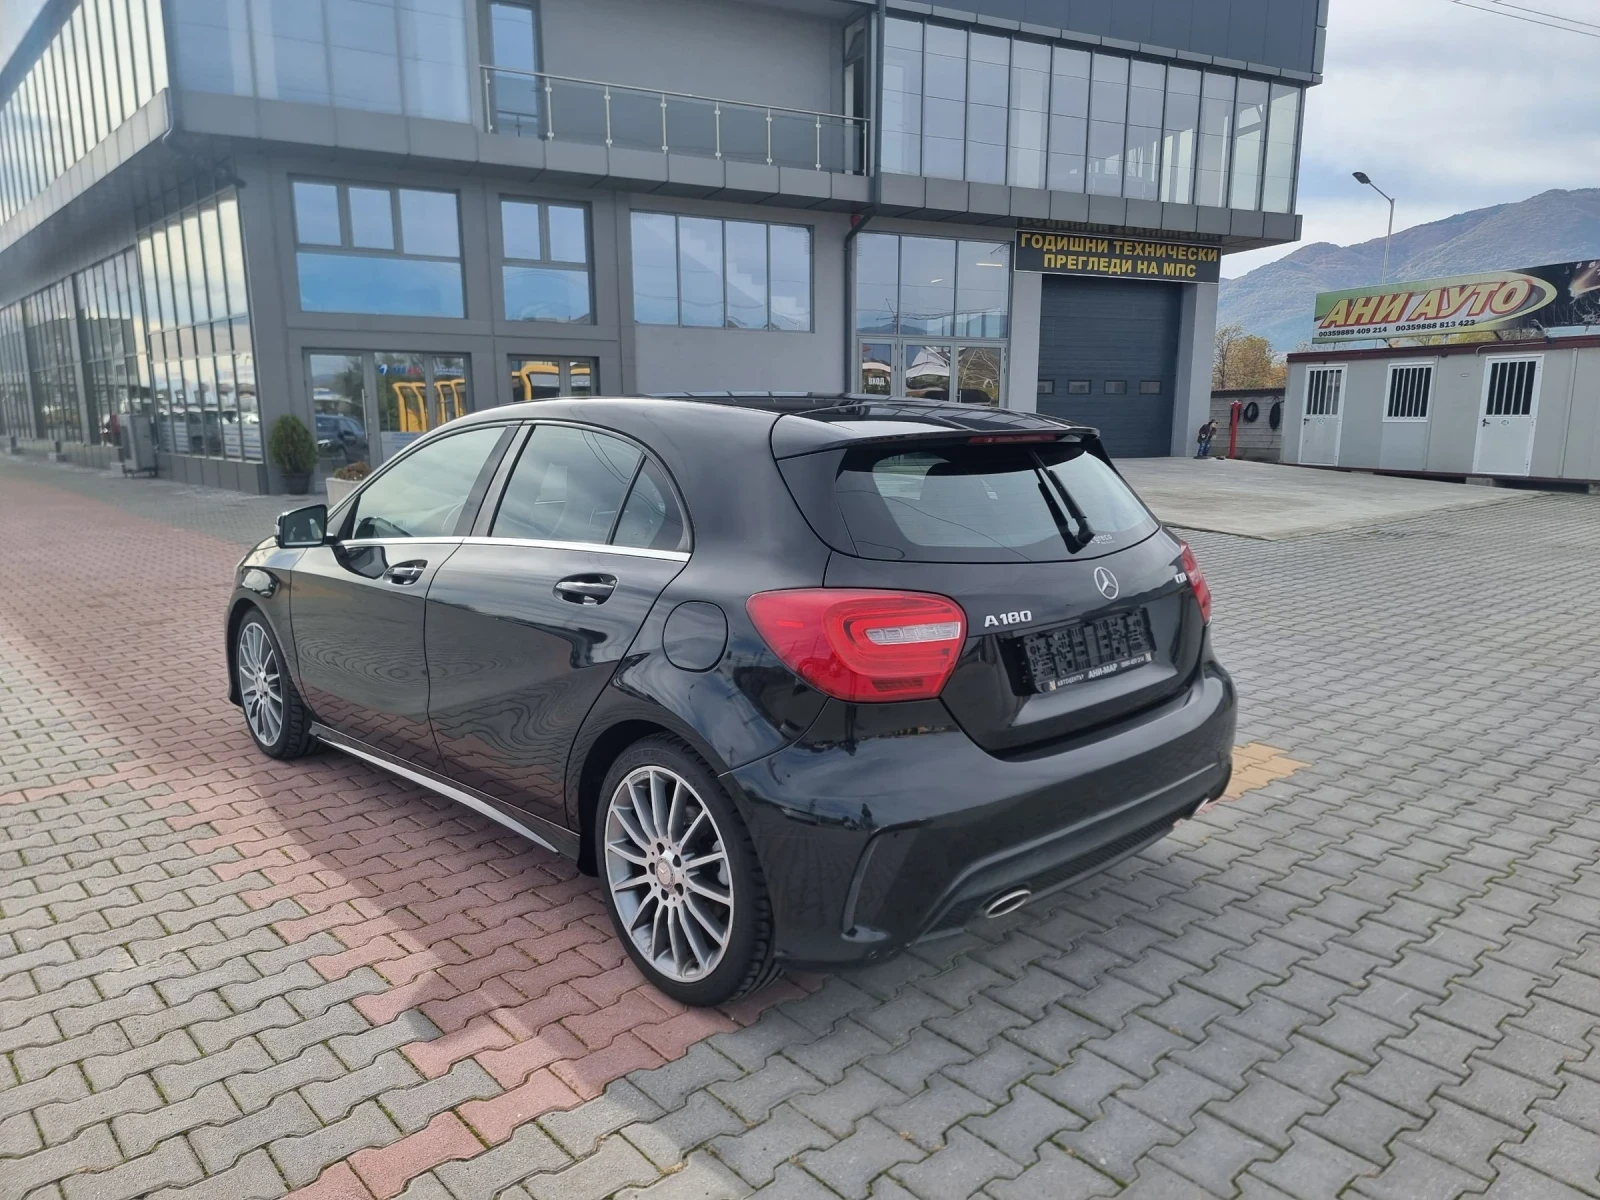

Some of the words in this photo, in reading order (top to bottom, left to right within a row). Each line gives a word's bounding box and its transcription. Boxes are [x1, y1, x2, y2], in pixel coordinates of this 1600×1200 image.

[1021, 233, 1108, 253] ГОДИШНИ
[1113, 240, 1218, 262] ТЕХНИЧЕСКИ
[1043, 253, 1133, 275] ПРЕГЛЕДИ
[1136, 261, 1159, 275] НА
[1162, 263, 1197, 278] МПС
[1318, 291, 1415, 329] АНИ
[1406, 279, 1532, 322] АУТО
[1318, 328, 1355, 337] 00359889
[1356, 327, 1371, 335] 409
[1372, 326, 1387, 334] 214
[1439, 320, 1456, 329] 813
[1457, 319, 1476, 328] 423
